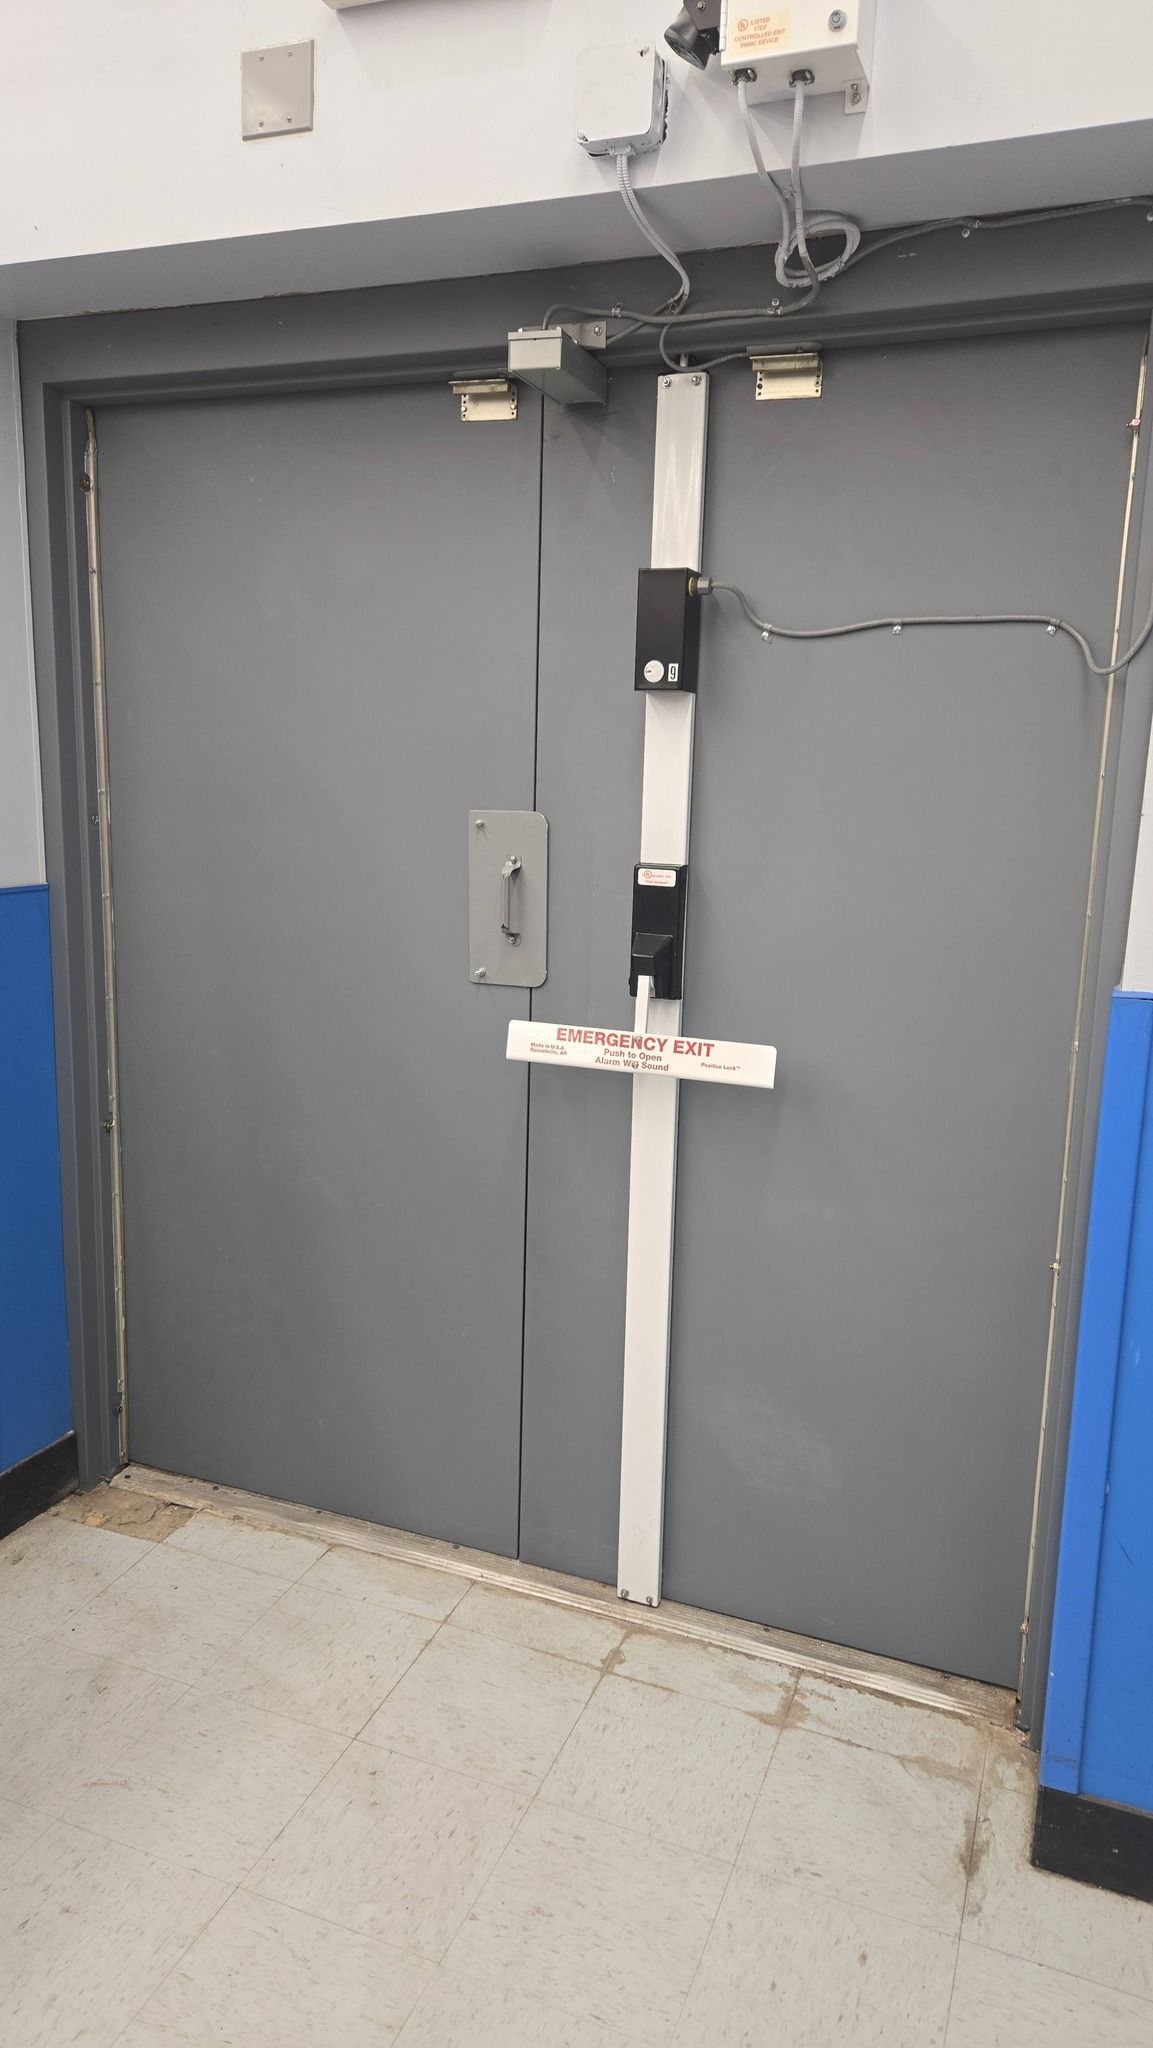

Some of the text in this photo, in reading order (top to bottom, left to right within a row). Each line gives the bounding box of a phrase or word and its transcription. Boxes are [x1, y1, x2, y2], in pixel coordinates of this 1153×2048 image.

[750, 16, 770, 25] LISTED
[734, 28, 786, 42] CONTROLLED EXIT
[740, 36, 779, 48] PANIC DEVICE
[670, 666, 676, 680] 9
[556, 1027, 715, 1057] EMERGENCY EXIT
[604, 1048, 662, 1062] Push to Open
[595, 1056, 620, 1066] Alarm
[641, 1061, 669, 1072] Sound
